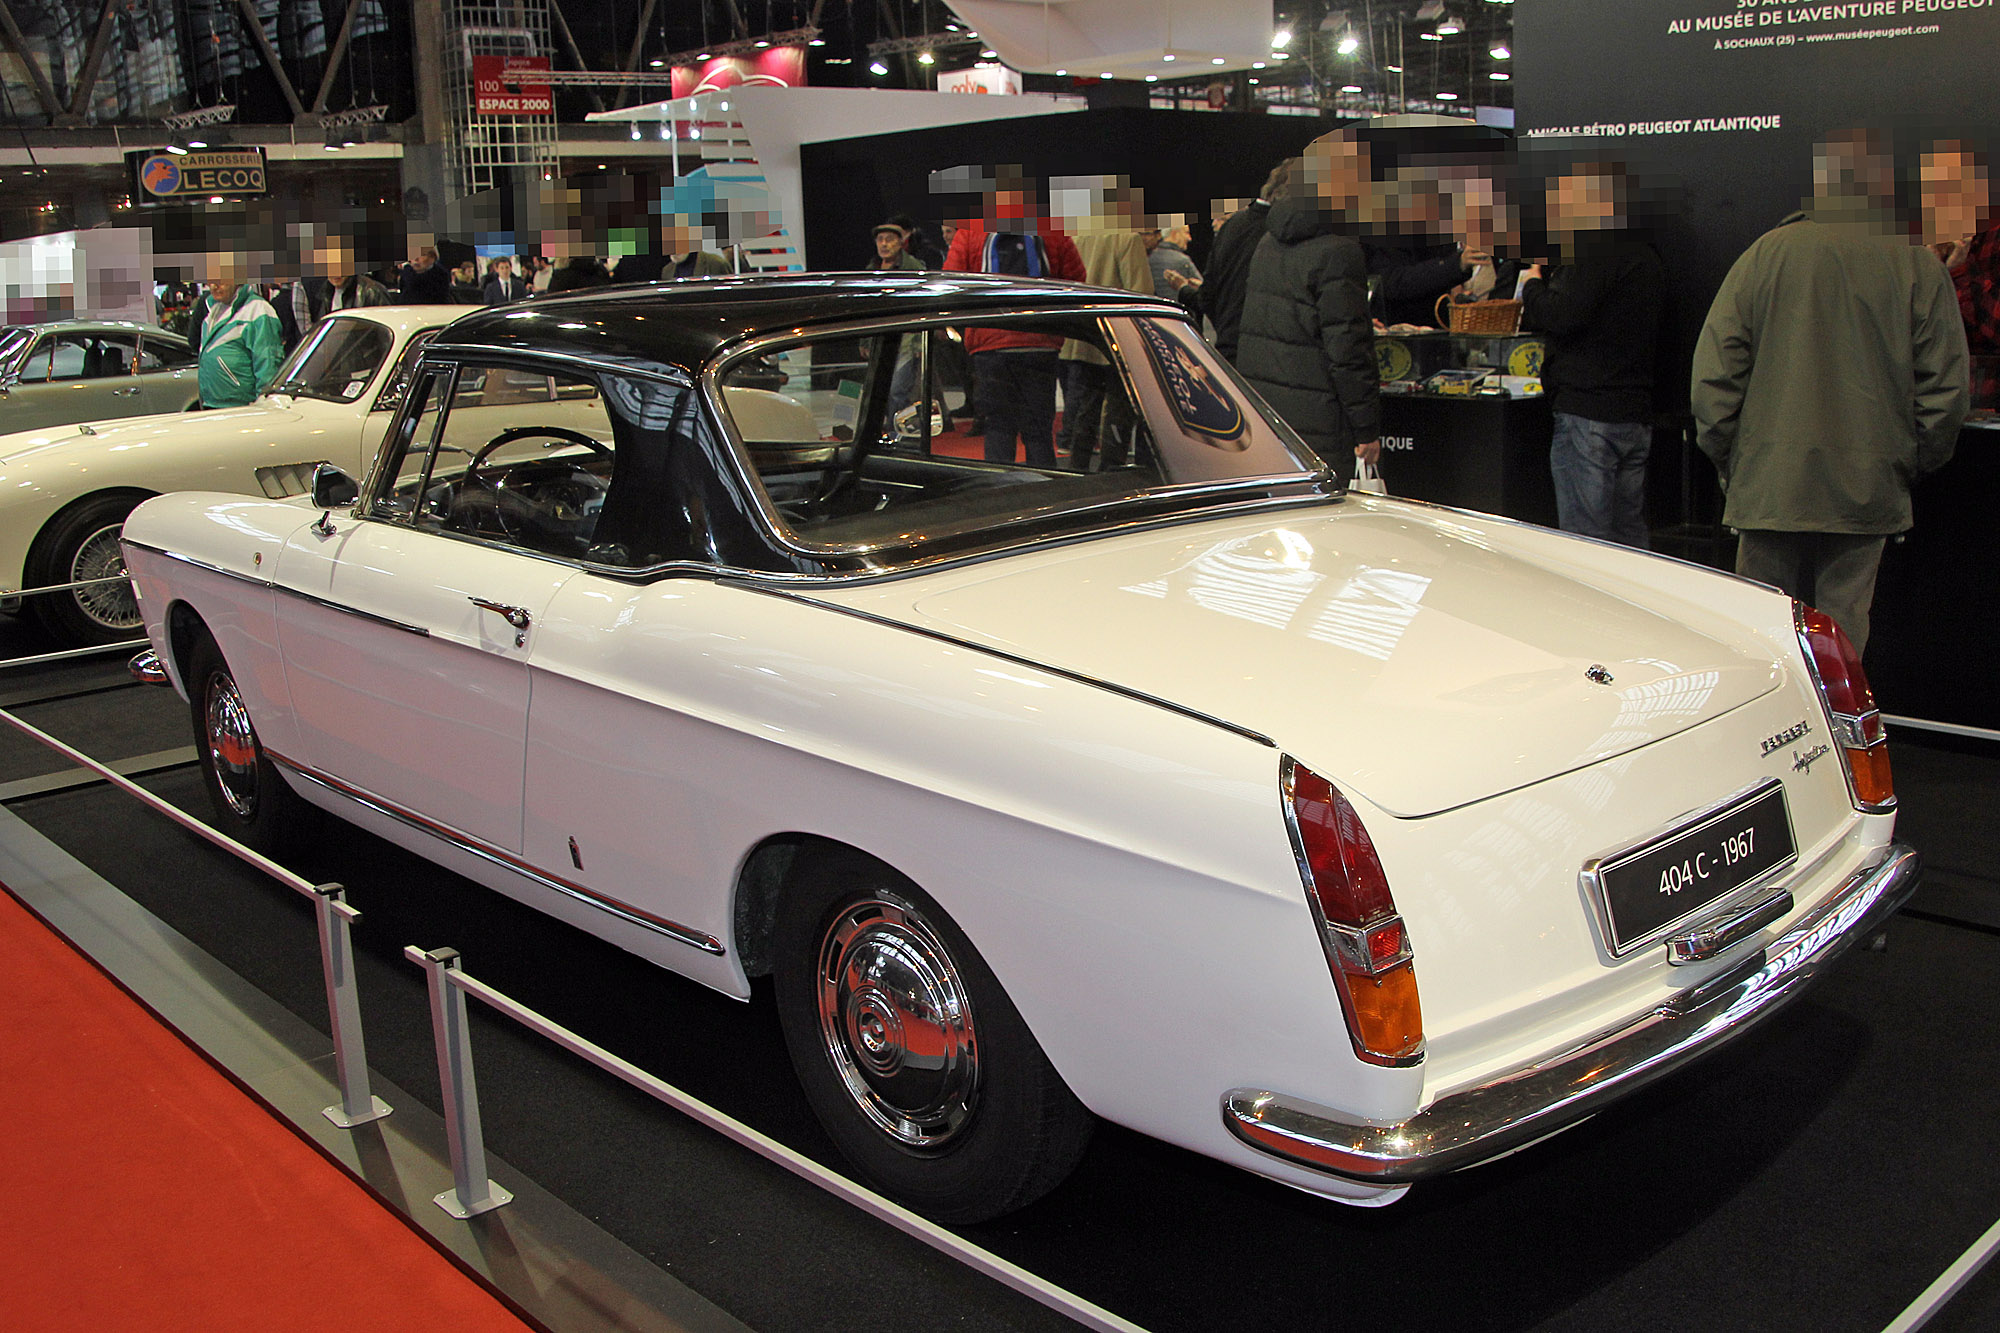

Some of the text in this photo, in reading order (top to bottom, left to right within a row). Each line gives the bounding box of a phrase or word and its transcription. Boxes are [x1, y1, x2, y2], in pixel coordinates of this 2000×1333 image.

[1667, 19, 1691, 34] AU
[1695, 11, 1754, 32] MUSÉE
[1759, 11, 1782, 26] DE
[1902, 0, 1994, 14] PEUGEOT
[1724, 36, 1775, 50] SOCHAUX
[1776, 34, 1796, 47] (25)
[1805, 24, 1940, 43] www.muséepeugeot.com
[479, 80, 499, 92] 100
[479, 98, 550, 110] ESPACE 2000
[1583, 121, 1625, 137] RÉTRO
[1628, 119, 1692, 136] PEUGEOT
[1693, 114, 1781, 132] ATLANTIQUE
[179, 154, 261, 166] CARROSSERIE
[183, 170, 263, 189] LECOQ
[1659, 859, 1694, 896] 404
[1695, 851, 1710, 879] C
[1720, 826, 1755, 866] 1967
